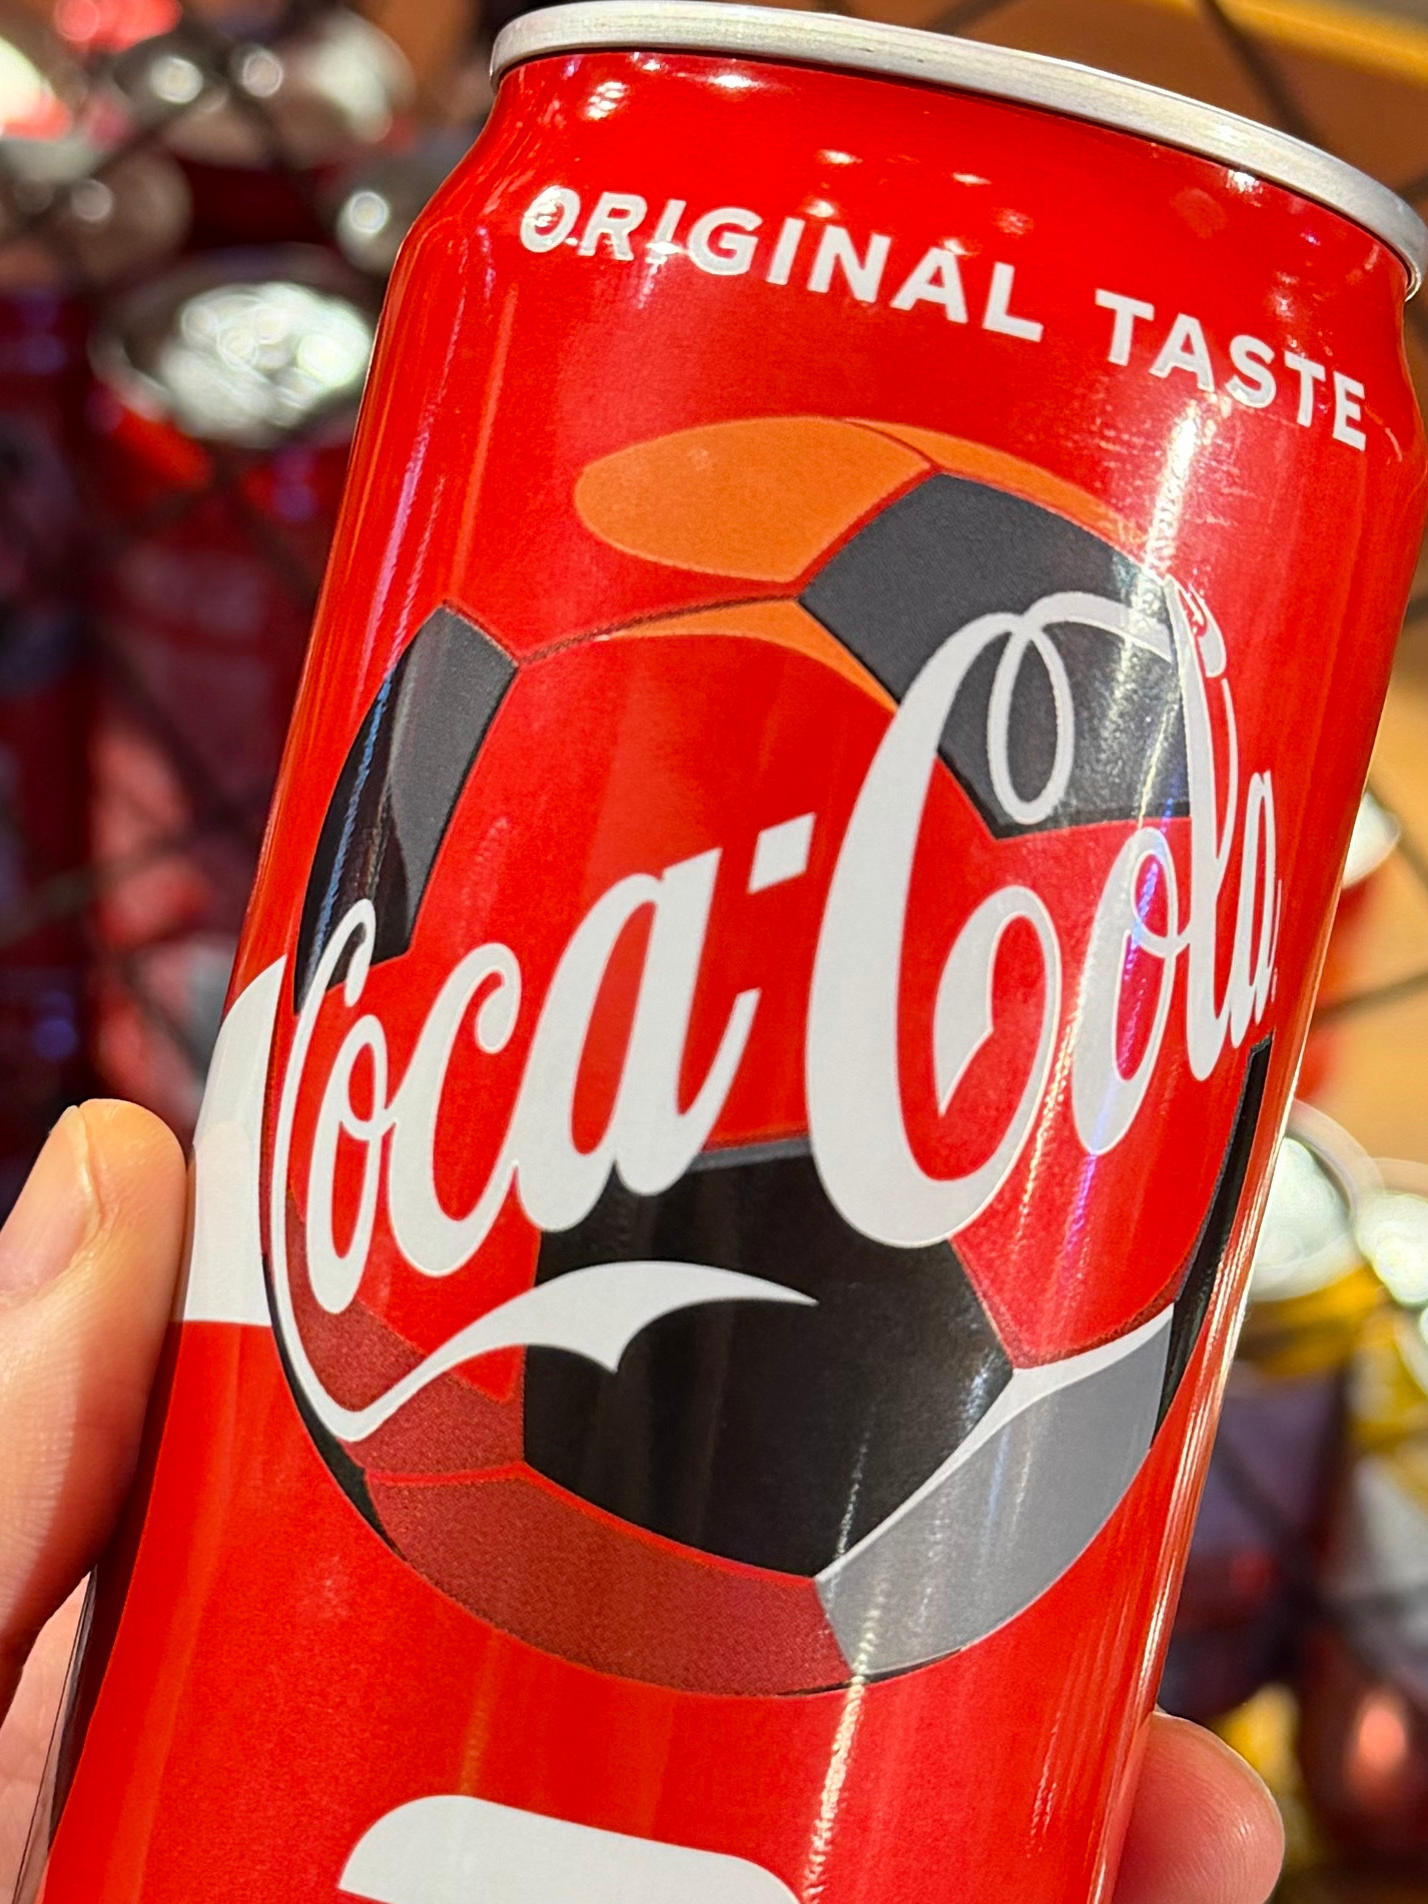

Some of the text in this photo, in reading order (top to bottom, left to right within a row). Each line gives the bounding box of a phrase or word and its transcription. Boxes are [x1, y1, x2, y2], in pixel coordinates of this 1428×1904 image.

[518, 183, 1368, 452] ORIGINAL TASTE
[269, 574, 1284, 1442] Coca-Cola
